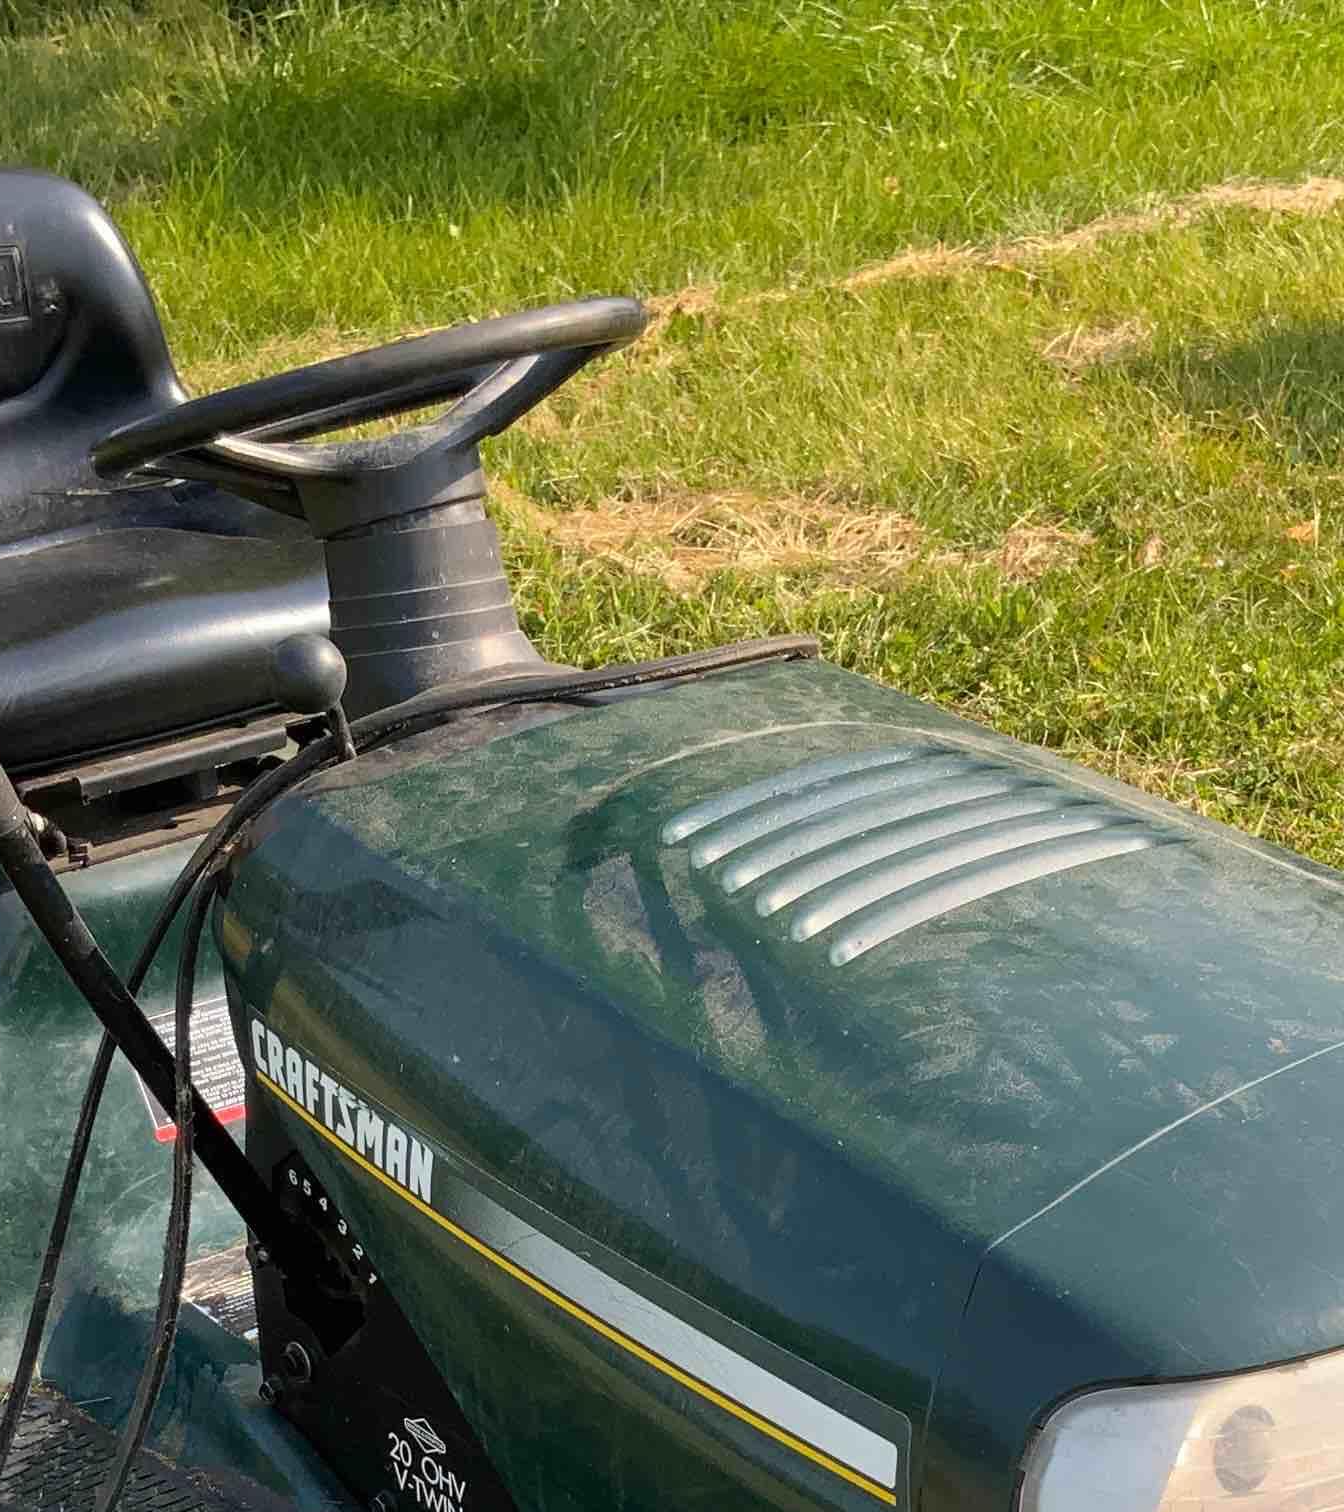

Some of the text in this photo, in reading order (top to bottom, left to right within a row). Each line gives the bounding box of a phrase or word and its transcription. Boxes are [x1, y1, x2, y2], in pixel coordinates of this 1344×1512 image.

[251, 1018, 434, 1204] CRAFTSMAN
[288, 1169, 298, 1186] 6
[303, 1178, 312, 1196] 5
[338, 1219, 348, 1236] 3
[352, 1243, 364, 1261] 2
[388, 1431, 412, 1467] 20
[421, 1456, 466, 1503] OHV
